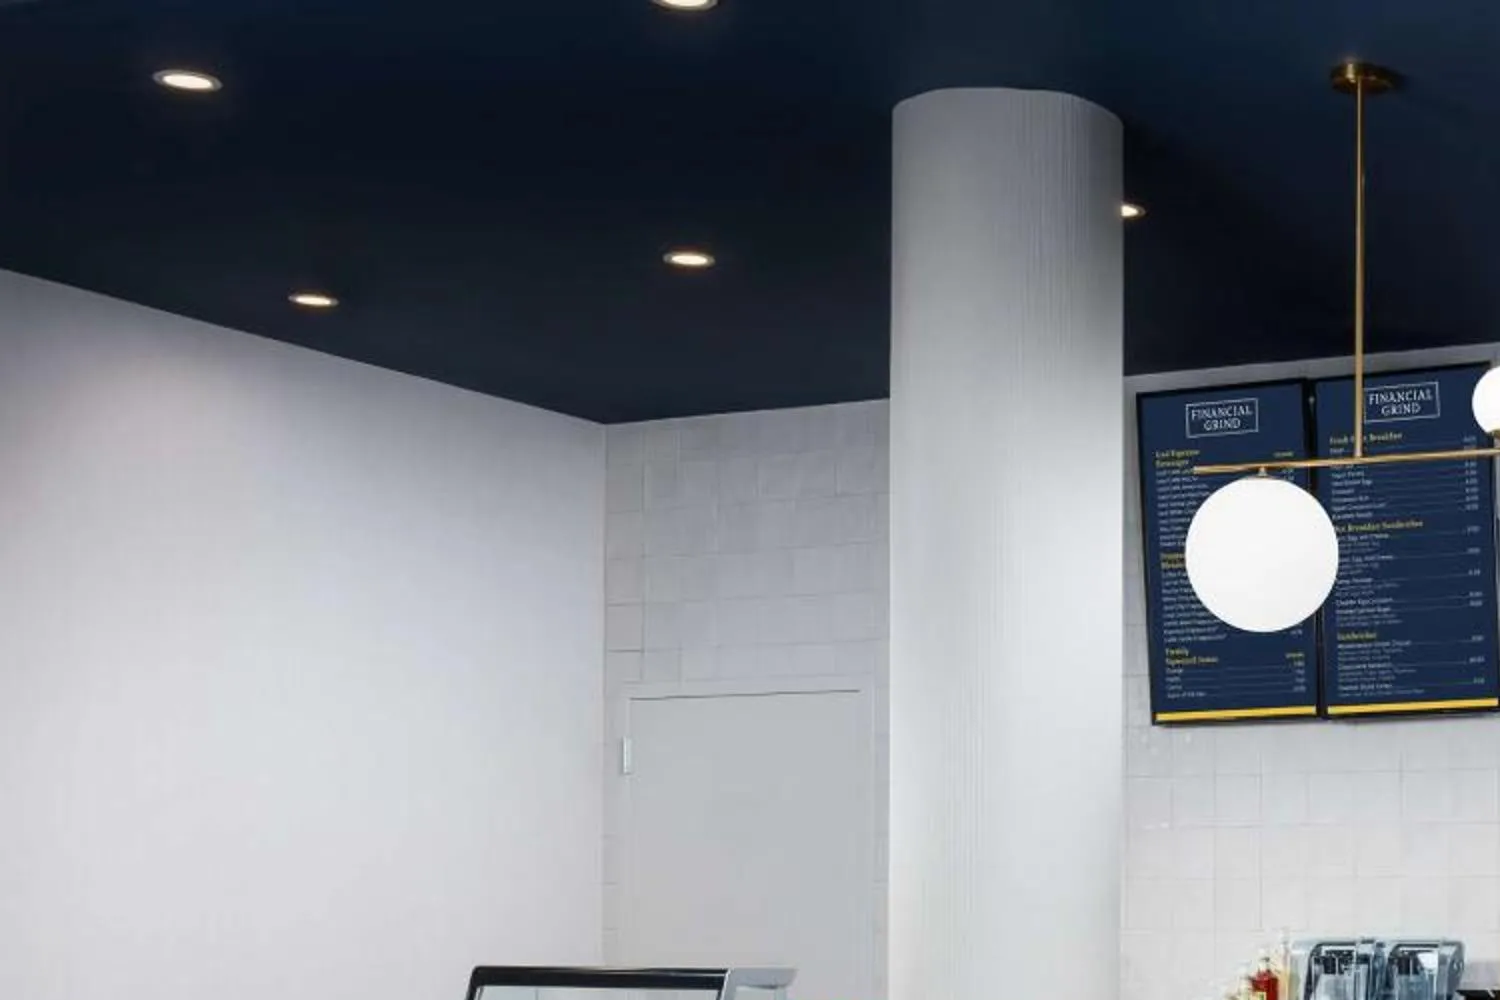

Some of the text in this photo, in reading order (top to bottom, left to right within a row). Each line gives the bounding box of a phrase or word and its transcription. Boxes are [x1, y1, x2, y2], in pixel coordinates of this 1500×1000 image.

[1369, 389, 1432, 405] FINANCIAL
[1191, 405, 1252, 421] FINANCIAL
[1381, 402, 1421, 416] GRIND
[1204, 417, 1241, 431] GRIND
